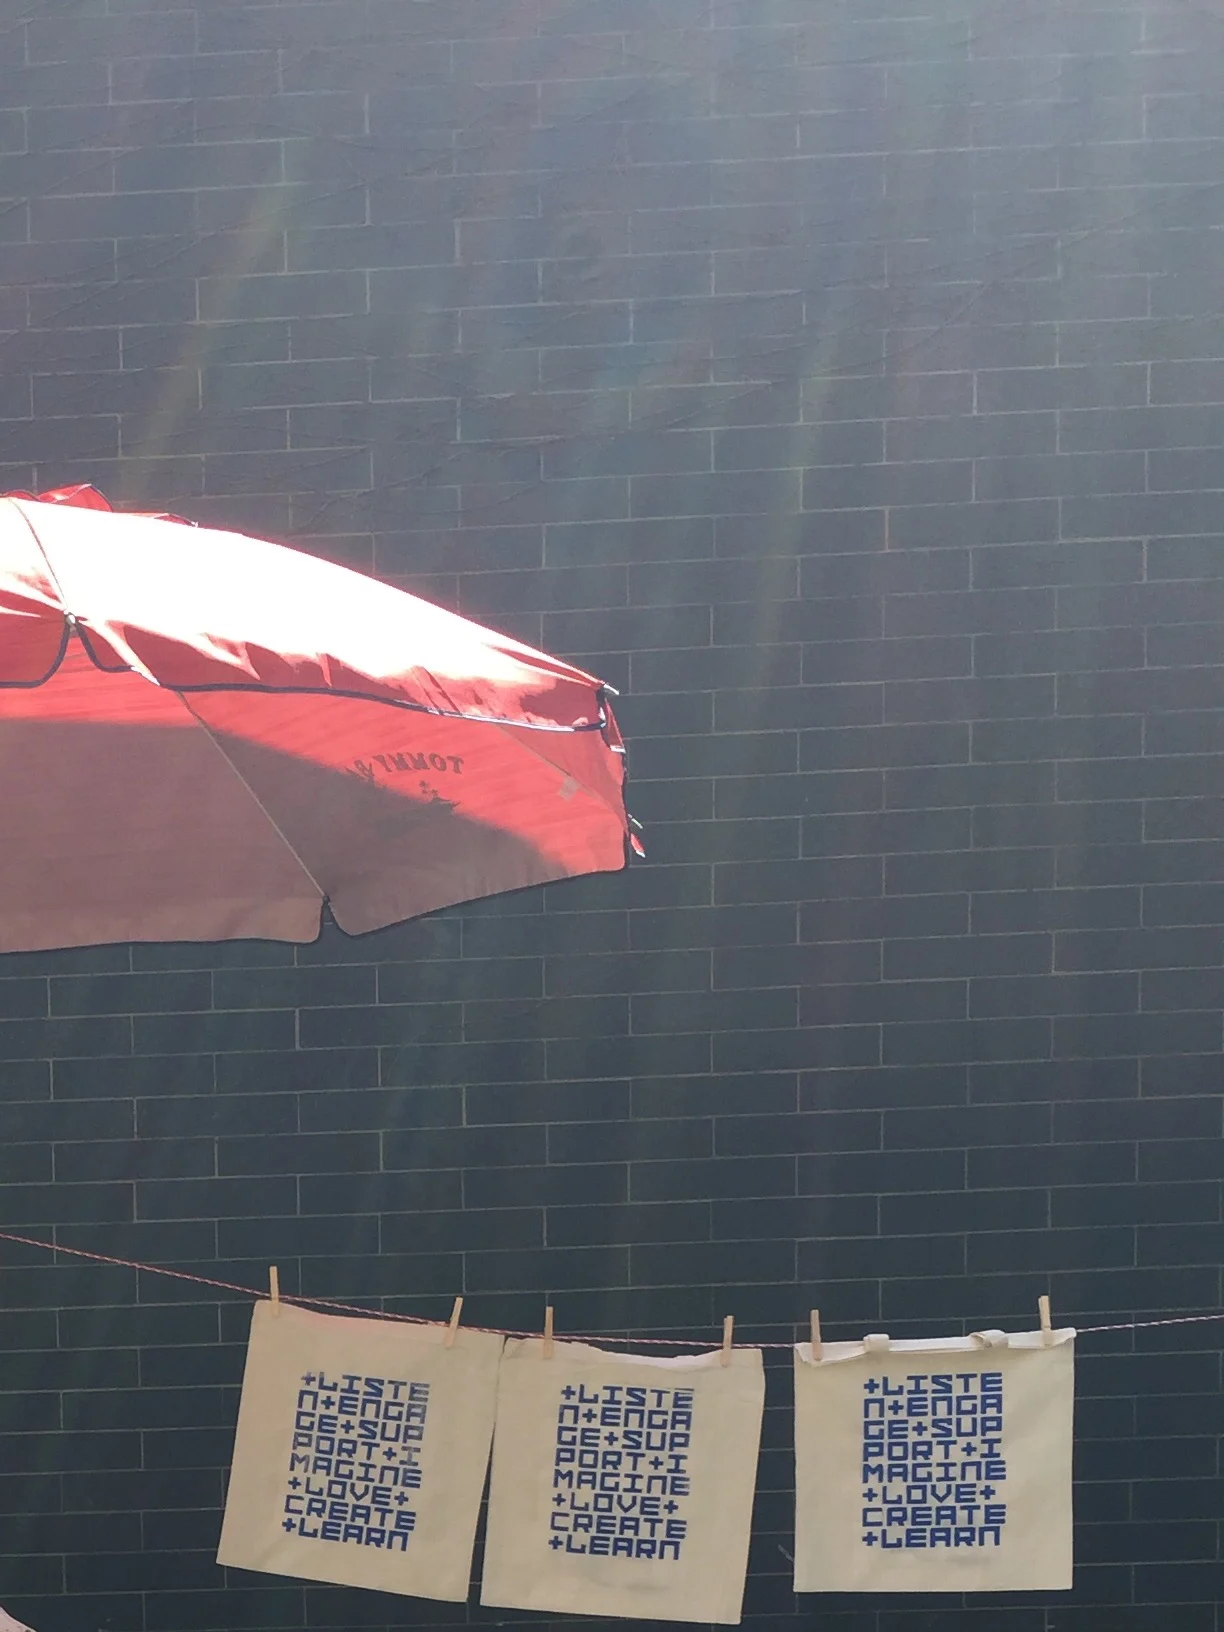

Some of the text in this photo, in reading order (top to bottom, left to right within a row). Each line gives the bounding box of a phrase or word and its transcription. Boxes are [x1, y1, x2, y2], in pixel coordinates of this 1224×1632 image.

[289, 1452, 422, 1489] MAGINE
[553, 1468, 690, 1496] MAGINE
[862, 1460, 1006, 1484] MAGINE
[284, 1494, 416, 1531] CREATE
[550, 1511, 687, 1539] CREATE
[862, 1504, 1006, 1527] CREATE
